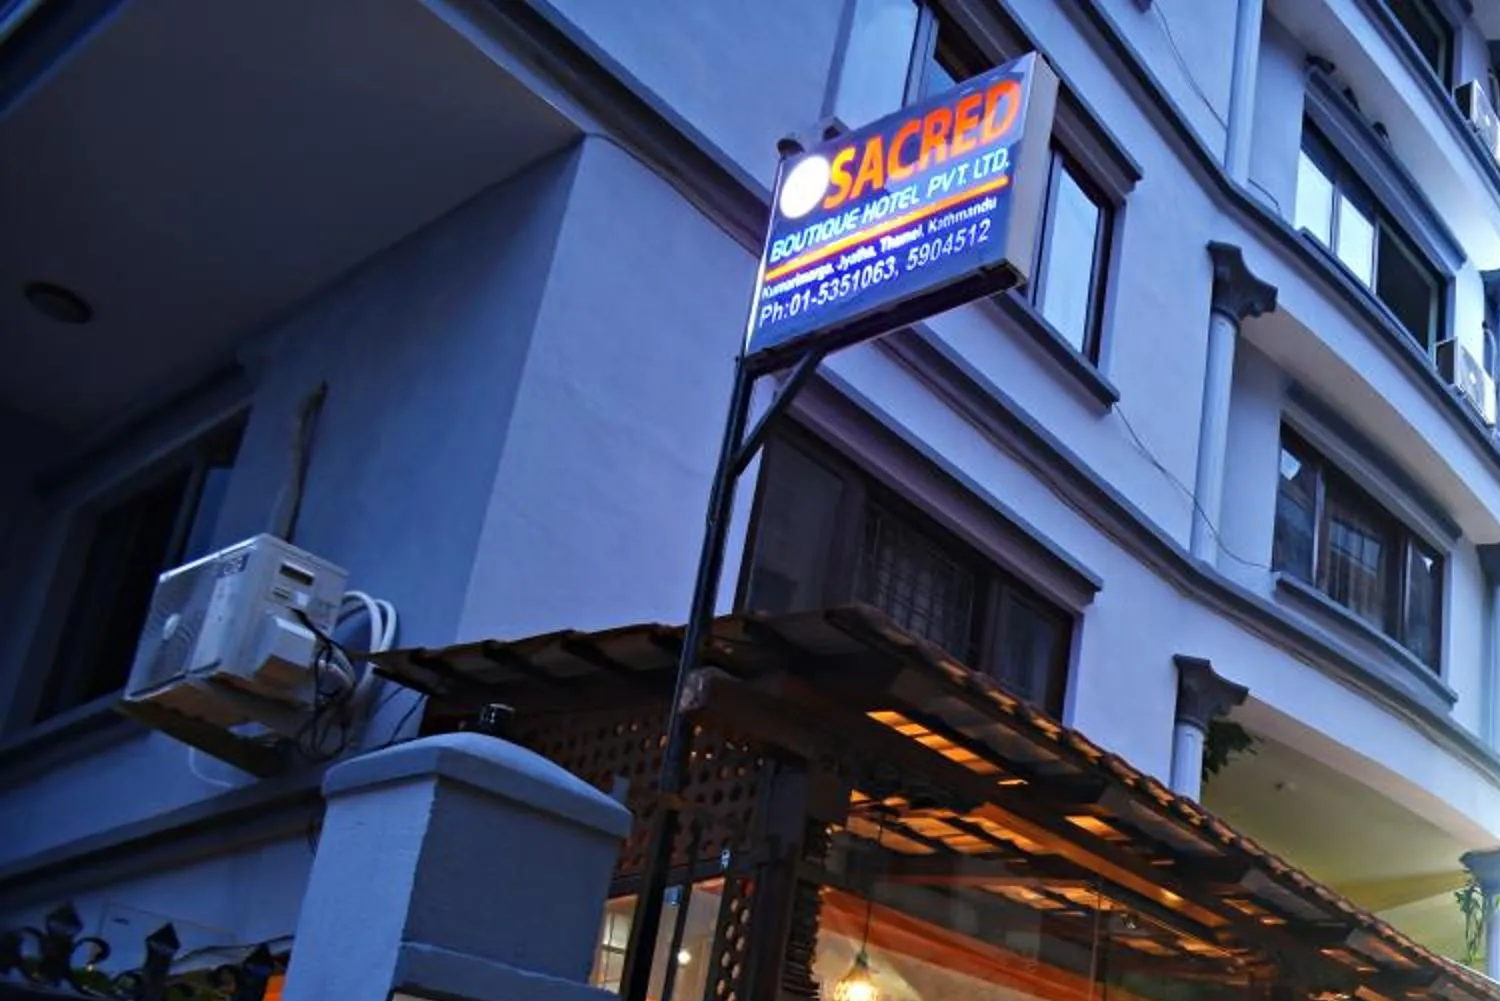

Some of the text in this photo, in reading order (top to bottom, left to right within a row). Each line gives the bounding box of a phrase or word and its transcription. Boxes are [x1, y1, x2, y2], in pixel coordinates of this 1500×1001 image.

[823, 79, 1022, 209] SACRED
[769, 207, 861, 263] BOUTIQUE
[861, 183, 921, 225] HOTEL
[905, 217, 991, 271] 5904512
[927, 196, 998, 234] Kathmandu
